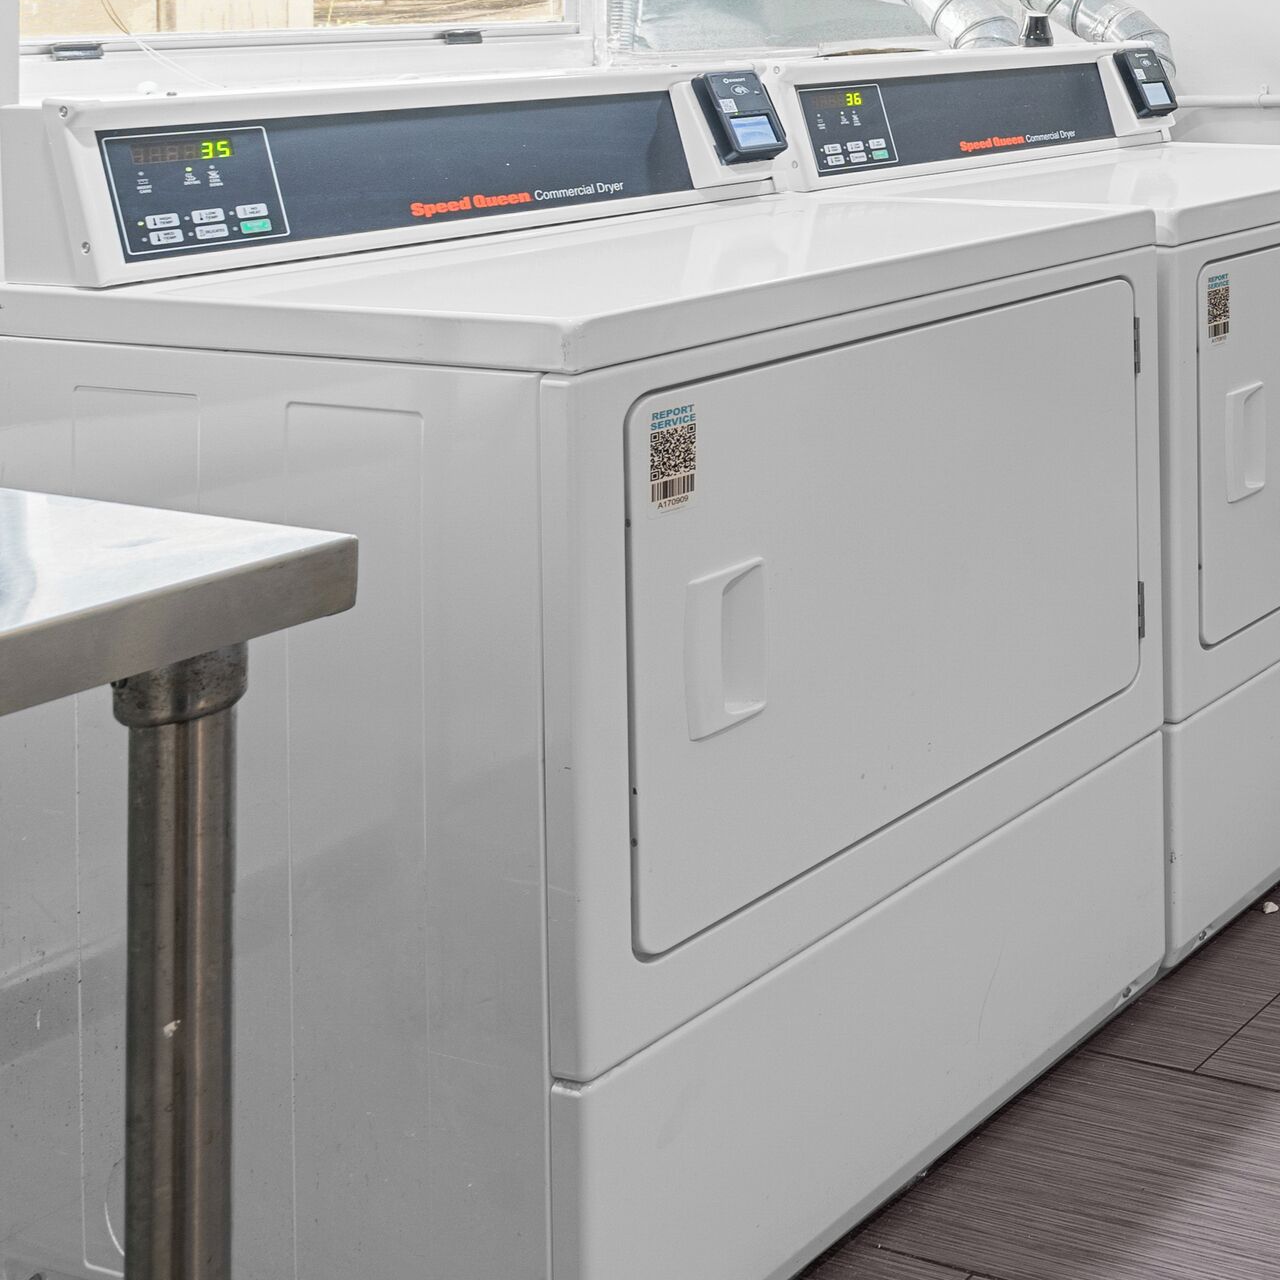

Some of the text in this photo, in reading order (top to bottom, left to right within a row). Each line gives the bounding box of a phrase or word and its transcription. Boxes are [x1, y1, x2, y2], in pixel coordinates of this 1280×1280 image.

[846, 93, 861, 106] 36
[201, 140, 231, 159] 35
[960, 130, 1075, 152] Speed Queen Commercial Dryer
[410, 181, 624, 218] Speed Queen Commercial Dryer
[652, 404, 694, 420] REPORT
[651, 414, 696, 431] SERVICE
